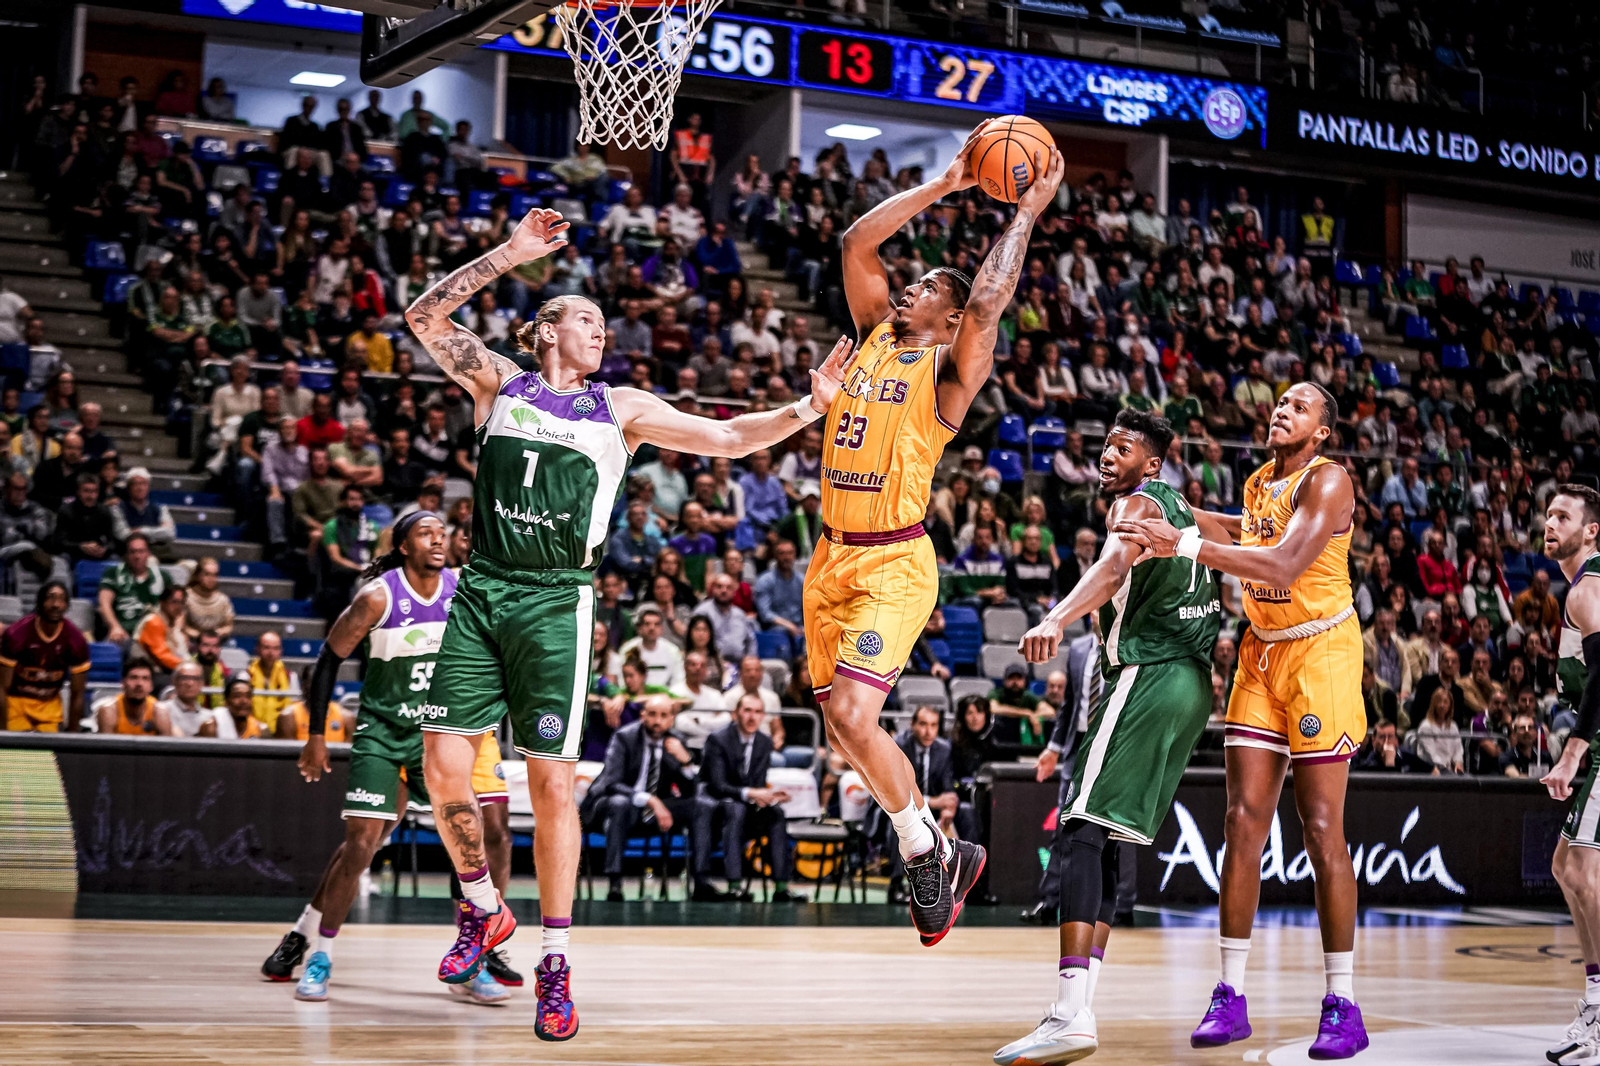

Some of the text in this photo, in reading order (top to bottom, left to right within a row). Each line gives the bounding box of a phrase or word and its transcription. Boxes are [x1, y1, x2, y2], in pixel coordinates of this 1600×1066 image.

[656, 14, 775, 77] 6:56
[821, 39, 873, 84] 13
[935, 54, 995, 103] 27
[1087, 73, 1168, 103] LIMOGES
[1104, 98, 1150, 126] CSP
[1298, 109, 1430, 156] PANTALLAS
[1436, 130, 1479, 162] LED
[1498, 139, 1588, 178] SONIDO
[833, 410, 869, 451] 23
[522, 449, 540, 488] 1
[494, 498, 556, 531] Andalucía
[852, 656, 872, 665] CRAFT
